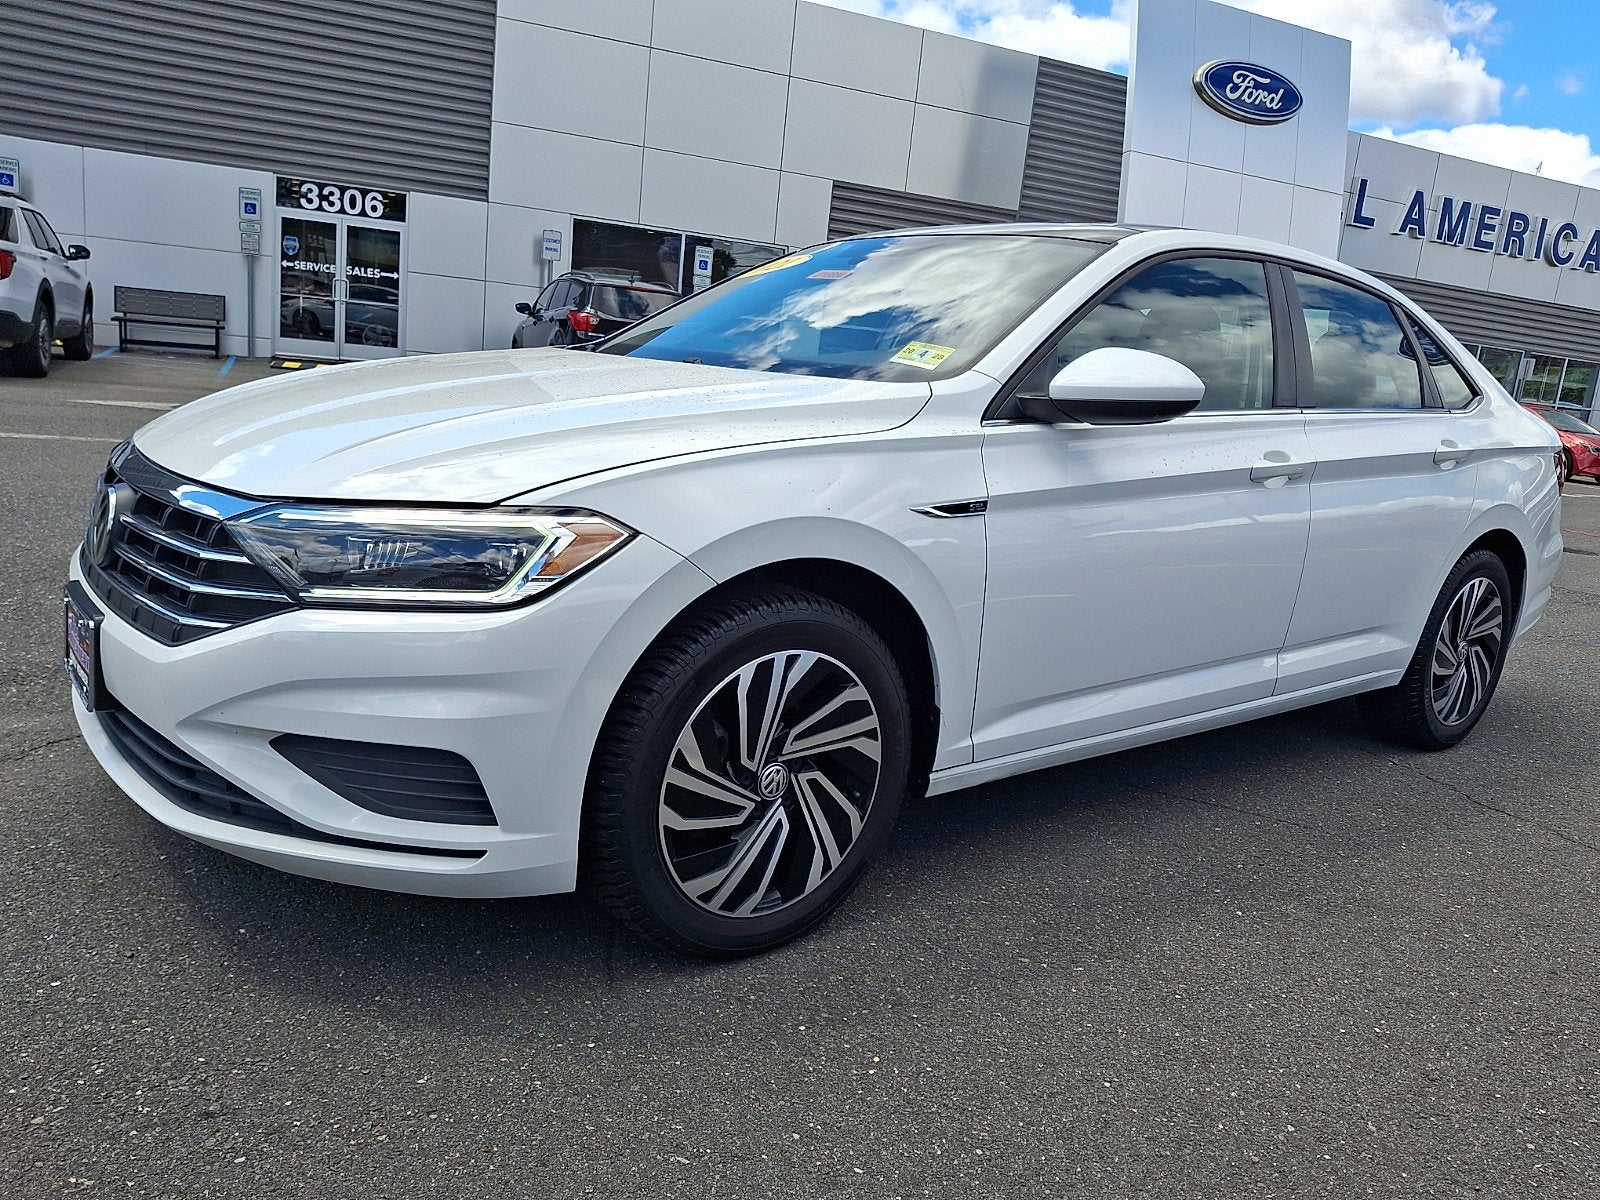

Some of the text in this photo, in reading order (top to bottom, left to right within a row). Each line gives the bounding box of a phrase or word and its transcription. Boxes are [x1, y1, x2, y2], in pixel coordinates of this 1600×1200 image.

[1226, 70, 1284, 109] Ford
[300, 183, 384, 218] 3306
[1352, 178, 1600, 273] L AMERICA
[294, 261, 380, 278] SERVICE SALES
